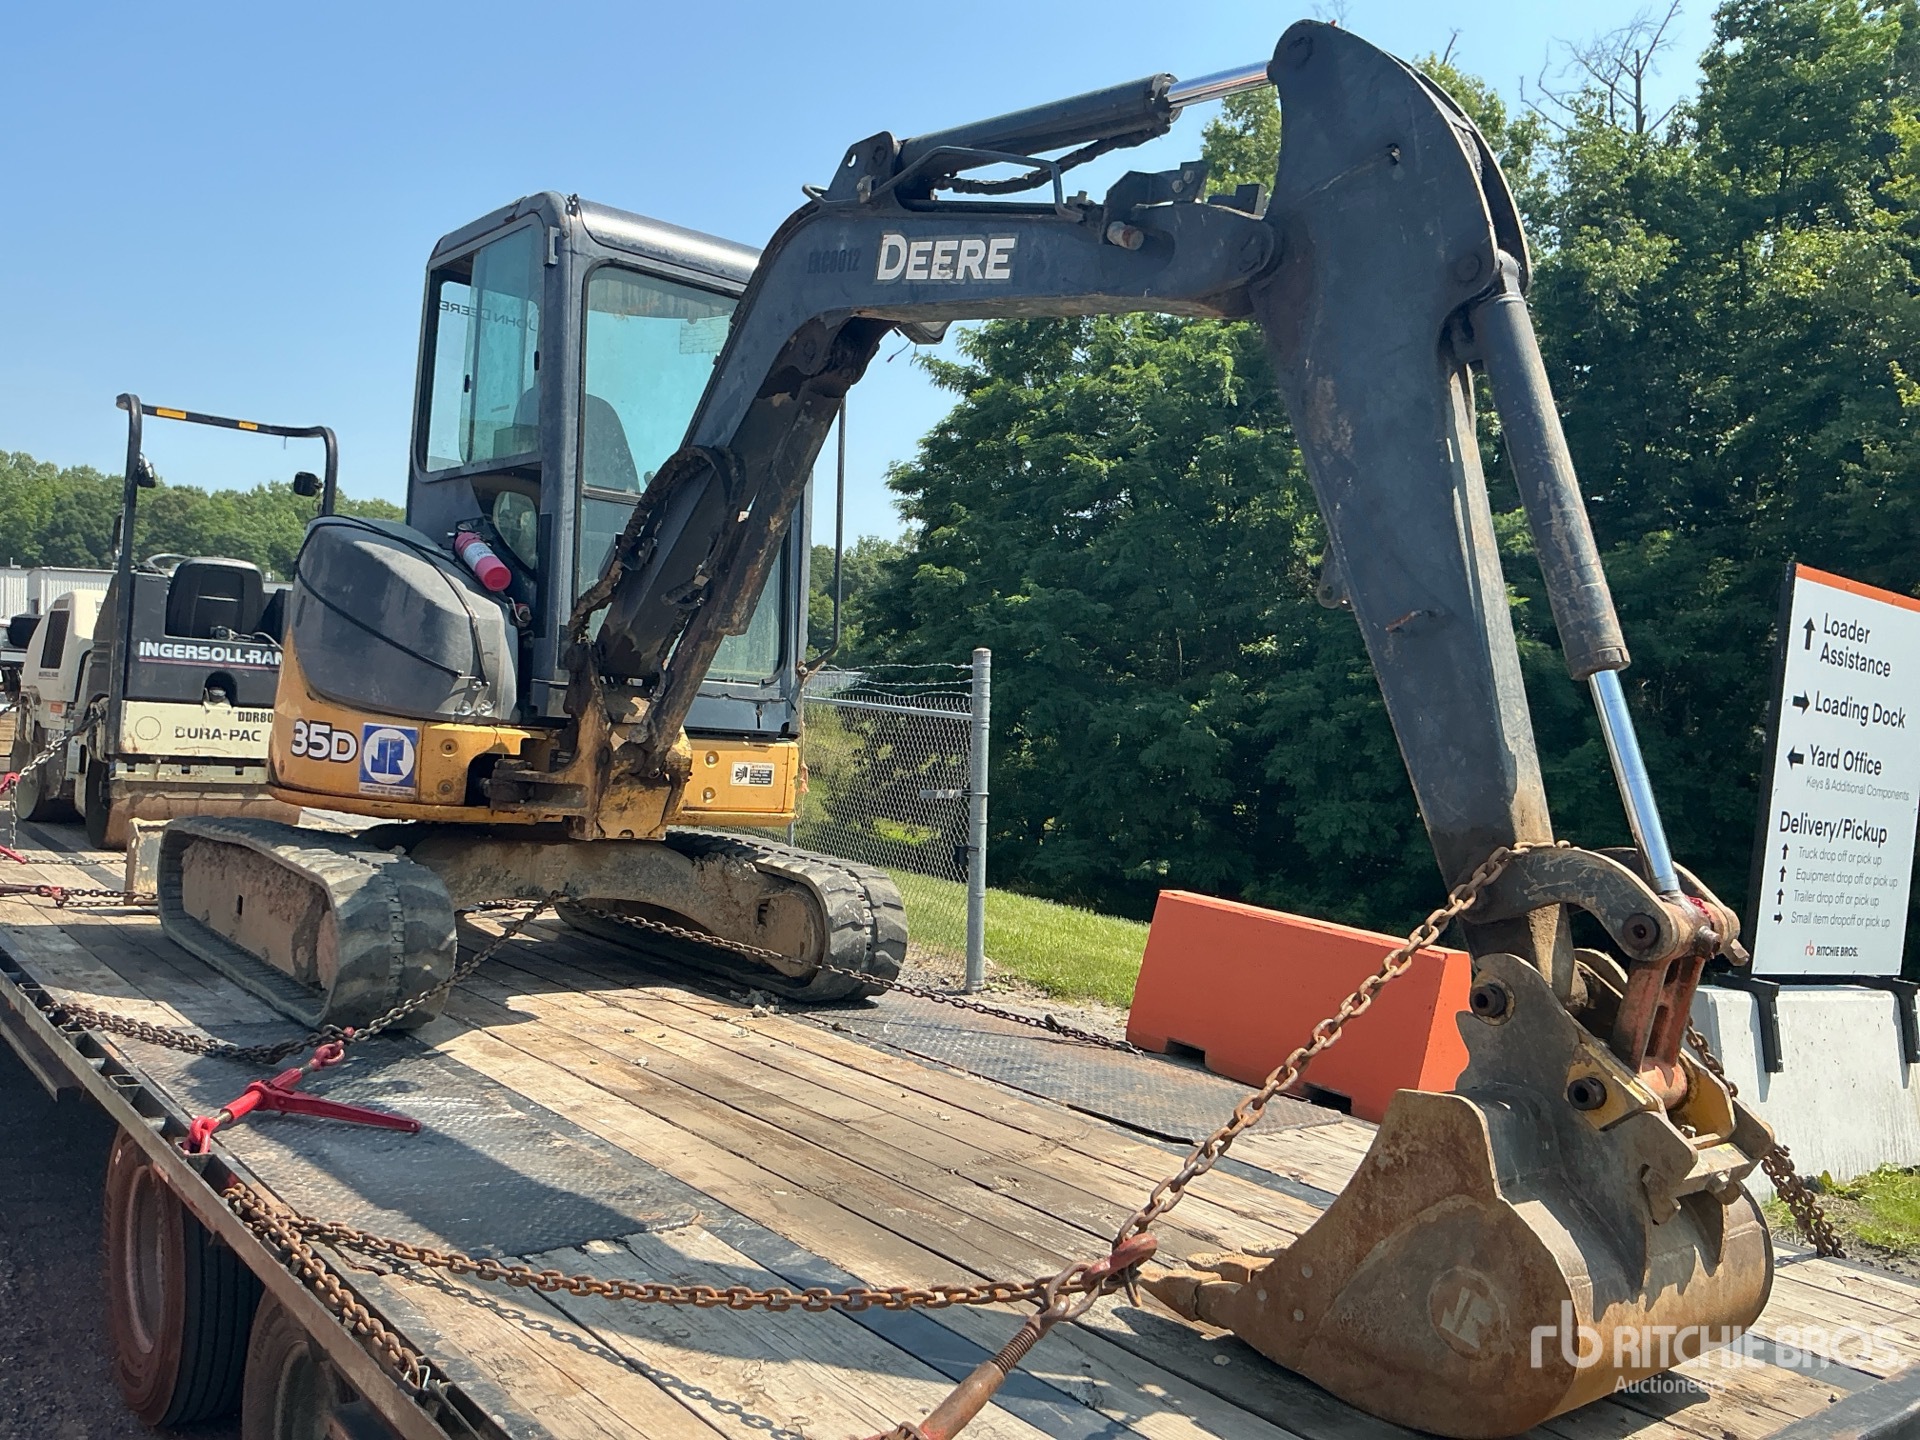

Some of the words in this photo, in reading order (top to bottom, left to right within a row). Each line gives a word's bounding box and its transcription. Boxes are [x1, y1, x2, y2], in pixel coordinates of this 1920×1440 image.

[877, 234, 1016, 280] DEERE
[1823, 612, 1870, 644] Loader
[1820, 642, 1891, 677] Assistance
[237, 711, 274, 724] DDR80
[1815, 690, 1869, 727] Loading
[1872, 703, 1906, 728] Dock
[174, 725, 262, 742] DURA-PAC
[291, 719, 358, 762] 35D
[1810, 744, 1841, 769] Yard
[1843, 750, 1882, 776] Office
[1806, 776, 1823, 790] Keys
[1825, 778, 1830, 790] &
[1831, 780, 1866, 794] Additional
[1866, 784, 1910, 801] Components
[1779, 811, 1888, 848] Delivery/Pickup
[1799, 846, 1819, 860] Truck
[1820, 849, 1836, 863] drop
[1837, 850, 1848, 861] off
[1848, 854, 1856, 863] or
[1856, 852, 1872, 866] pick
[1873, 856, 1882, 867] up
[1795, 868, 1836, 884] Equipment
[1836, 872, 1853, 886] drop
[1854, 873, 1864, 884] off
[1865, 876, 1872, 885] or
[1873, 875, 1887, 889] pick
[1889, 878, 1898, 889] up
[1794, 890, 1816, 903] Trailer
[1817, 891, 1834, 907] drop
[1835, 892, 1845, 904] off
[1845, 895, 1853, 905] or
[1854, 894, 1869, 908] pick
[1870, 898, 1879, 909] up
[1791, 911, 1812, 924] Small
[1813, 914, 1829, 924] item
[1857, 917, 1864, 927] or
[1865, 915, 1880, 928] pick
[1881, 918, 1890, 929] up
[1816, 946, 1840, 957] RITCHIE
